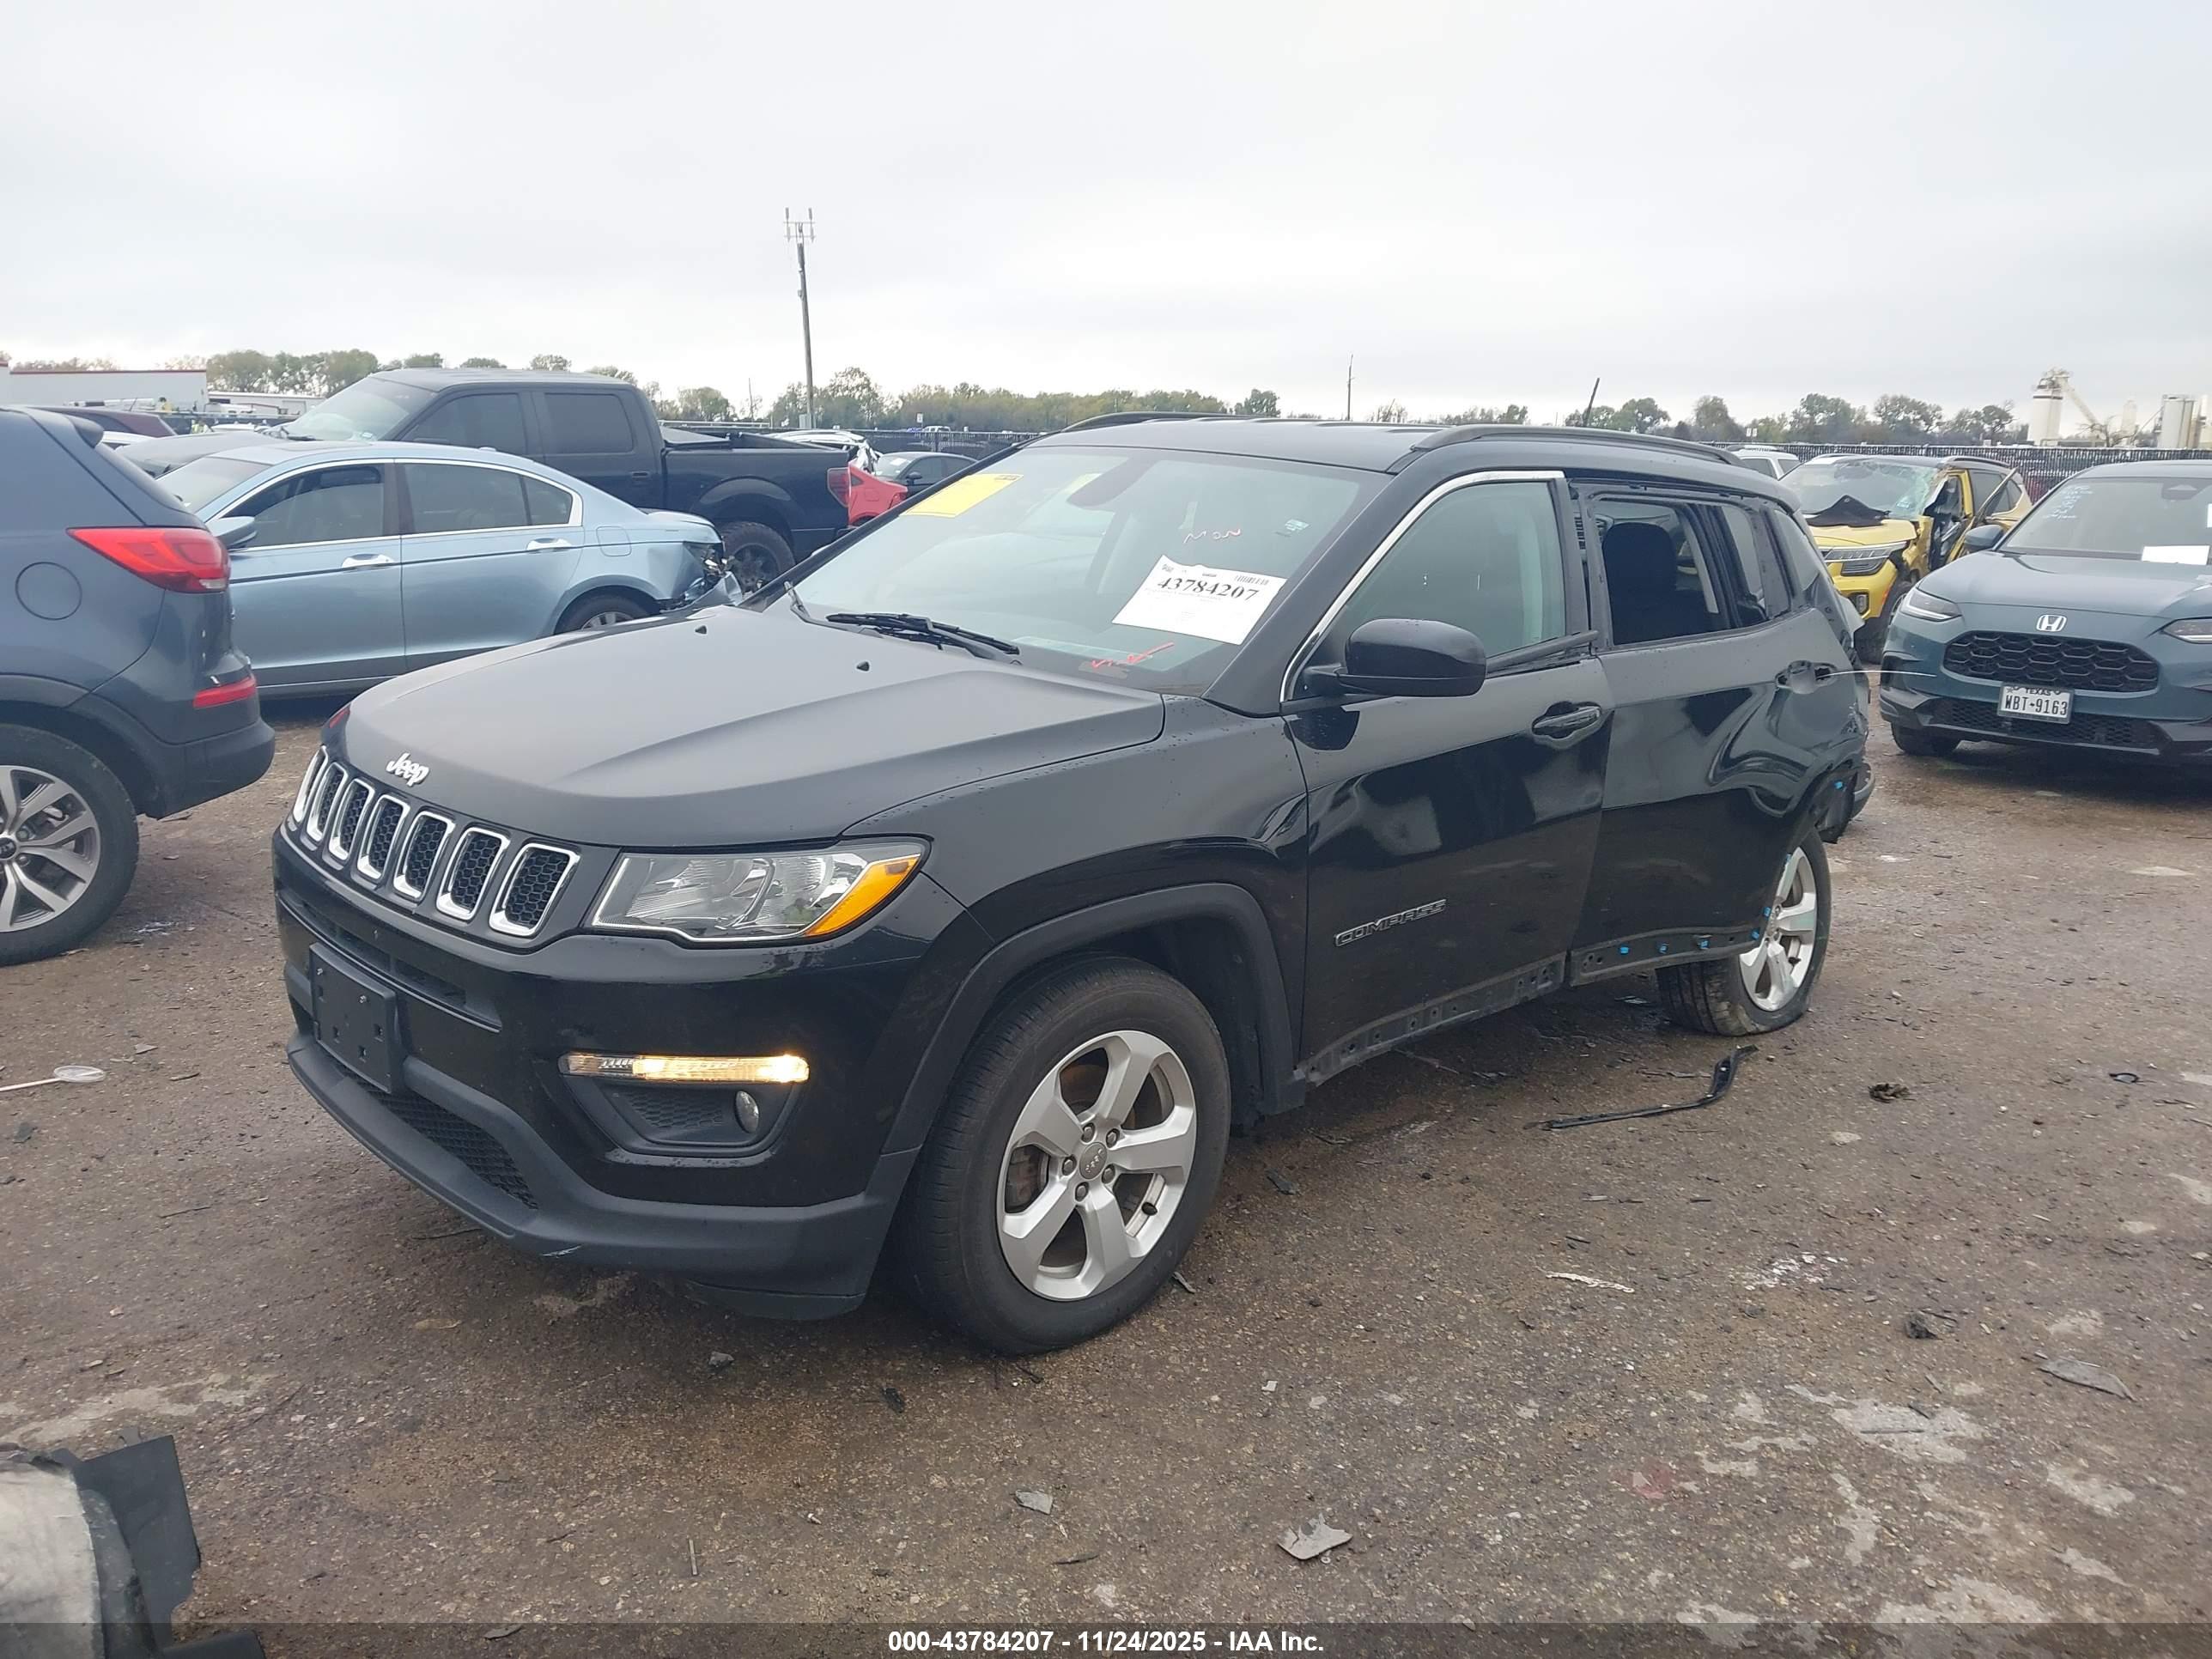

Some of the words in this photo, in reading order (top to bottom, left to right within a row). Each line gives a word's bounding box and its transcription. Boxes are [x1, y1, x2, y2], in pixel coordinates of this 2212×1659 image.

[1157, 576, 1260, 601] 43784207
[2025, 686, 2051, 696] TEXAS
[386, 752, 429, 787] Jeep
[1335, 899, 1447, 947] COMPASS
